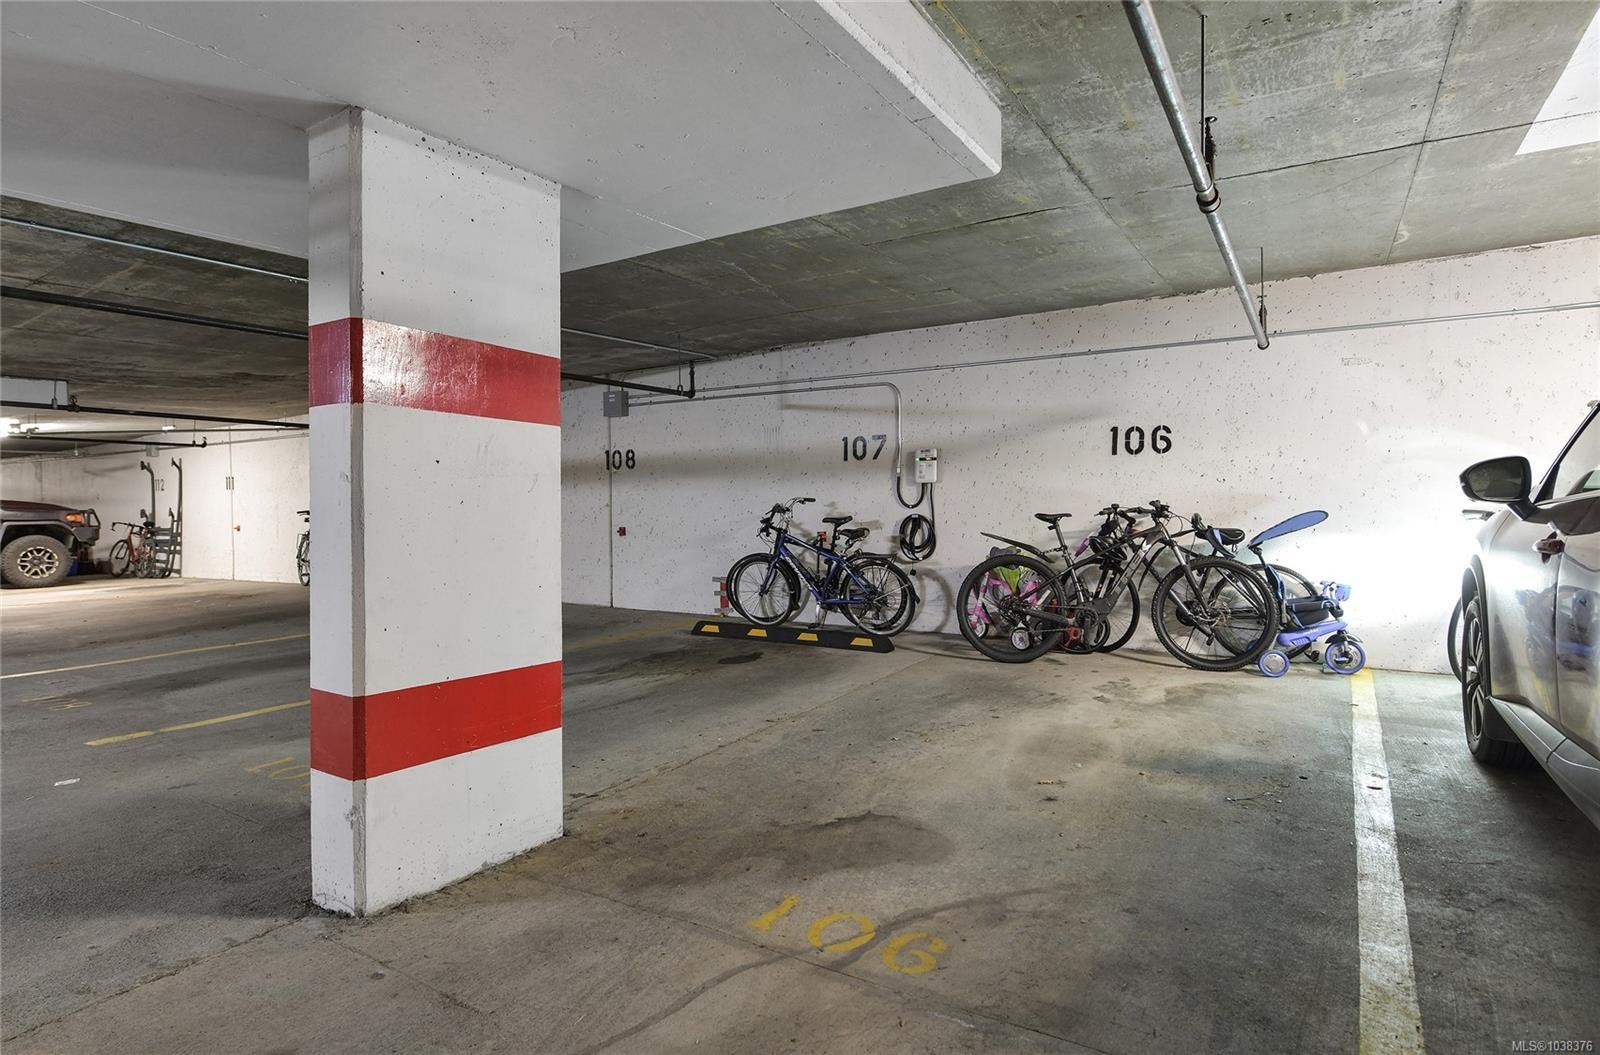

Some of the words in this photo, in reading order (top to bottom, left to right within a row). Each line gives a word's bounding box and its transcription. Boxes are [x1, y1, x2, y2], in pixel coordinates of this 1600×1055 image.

[841, 434, 887, 461] 107
[1110, 424, 1172, 456] 106
[604, 448, 636, 471] 108
[247, 754, 311, 789] 10
[747, 891, 949, 976] 106
